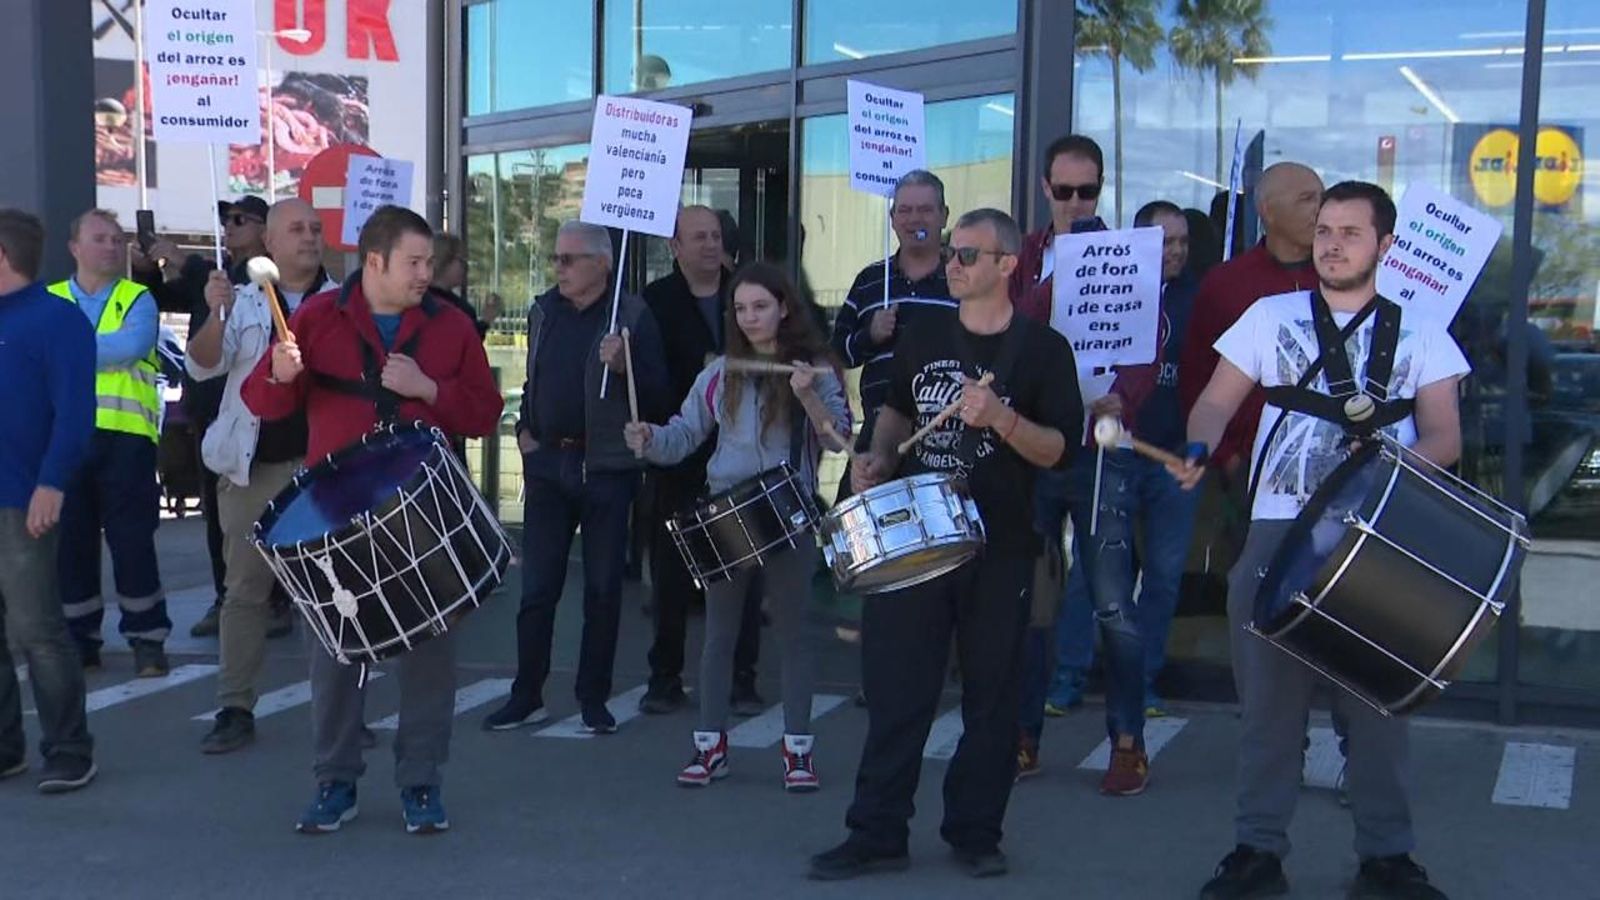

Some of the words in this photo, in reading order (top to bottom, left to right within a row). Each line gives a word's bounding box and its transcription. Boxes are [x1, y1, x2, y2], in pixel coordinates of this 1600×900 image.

[171, 7, 227, 21] Ocultar
[167, 30, 181, 41] el
[185, 30, 234, 46] origen
[157, 51, 181, 63] del
[185, 54, 224, 66] arroz
[228, 56, 246, 66] es
[166, 73, 239, 88] ¡engañar!
[197, 95, 211, 107] al
[865, 93, 904, 110] Ocultar
[160, 115, 249, 128] consumidor
[605, 102, 679, 128] Distribuidoras
[861, 109, 872, 119] el
[874, 112, 909, 126] origen
[621, 128, 657, 143] mucha
[854, 124, 871, 135] del
[874, 129, 902, 141] arroz
[904, 135, 917, 144] es
[606, 144, 667, 165] valencianía
[882, 160, 893, 170] al
[621, 167, 646, 180] pero
[855, 171, 902, 186] consum
[617, 185, 643, 200] poca
[600, 201, 655, 221] vergüenza
[1425, 202, 1473, 235] Ocultar
[1409, 220, 1424, 233] el
[1425, 228, 1466, 257] origen
[1082, 244, 1131, 259] Arròs
[1075, 264, 1097, 278] de
[1101, 262, 1139, 276] fora
[1412, 247, 1448, 272] arroz
[1448, 267, 1464, 281] es
[1079, 282, 1133, 296] duran
[1400, 287, 1416, 301] al
[1077, 301, 1100, 315] de
[1104, 300, 1143, 314] casa
[1089, 320, 1121, 332] ens
[1073, 336, 1133, 351] tiraran
